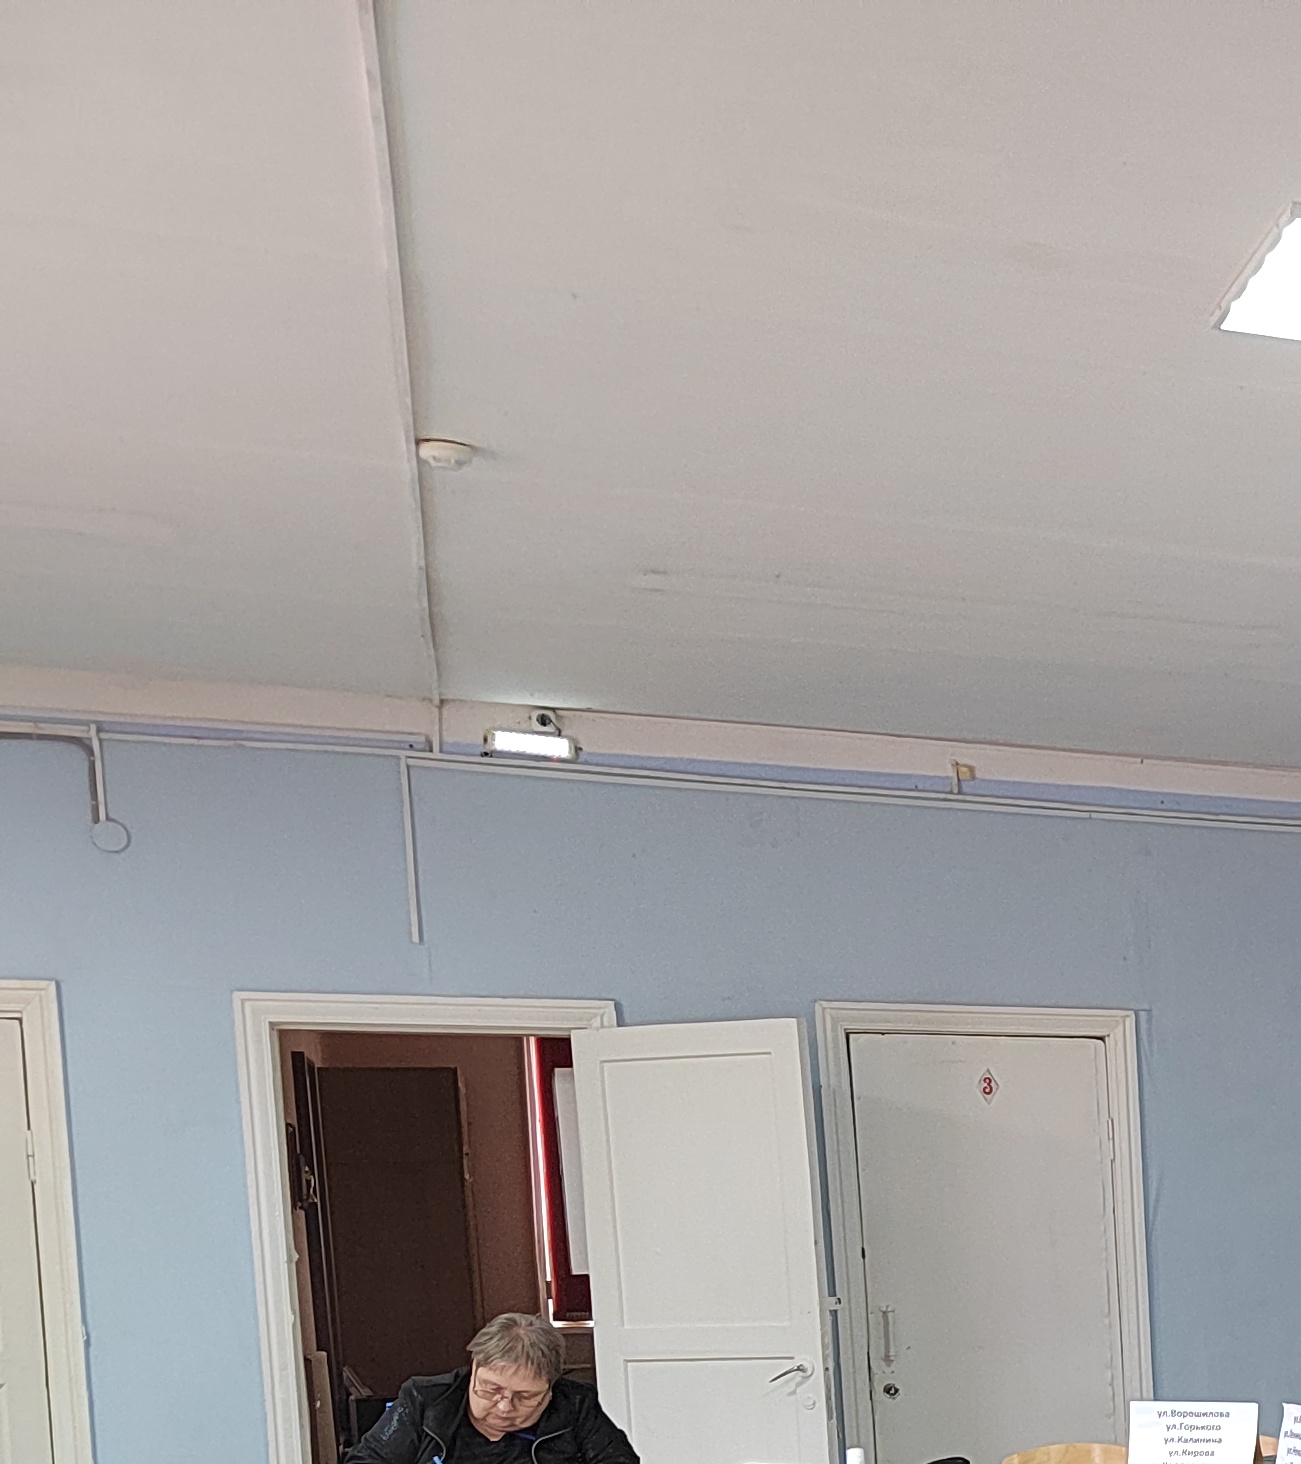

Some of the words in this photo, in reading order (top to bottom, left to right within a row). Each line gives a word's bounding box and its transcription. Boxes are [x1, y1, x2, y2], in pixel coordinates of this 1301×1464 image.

[982, 1076, 994, 1095] 3
[1157, 1409, 1230, 1419] ул.Ворошилова
[1166, 1422, 1221, 1432] ул.Горького
[1164, 1435, 1222, 1445] ул.Калинина
[1168, 1449, 1215, 1458] ул.Кирова
